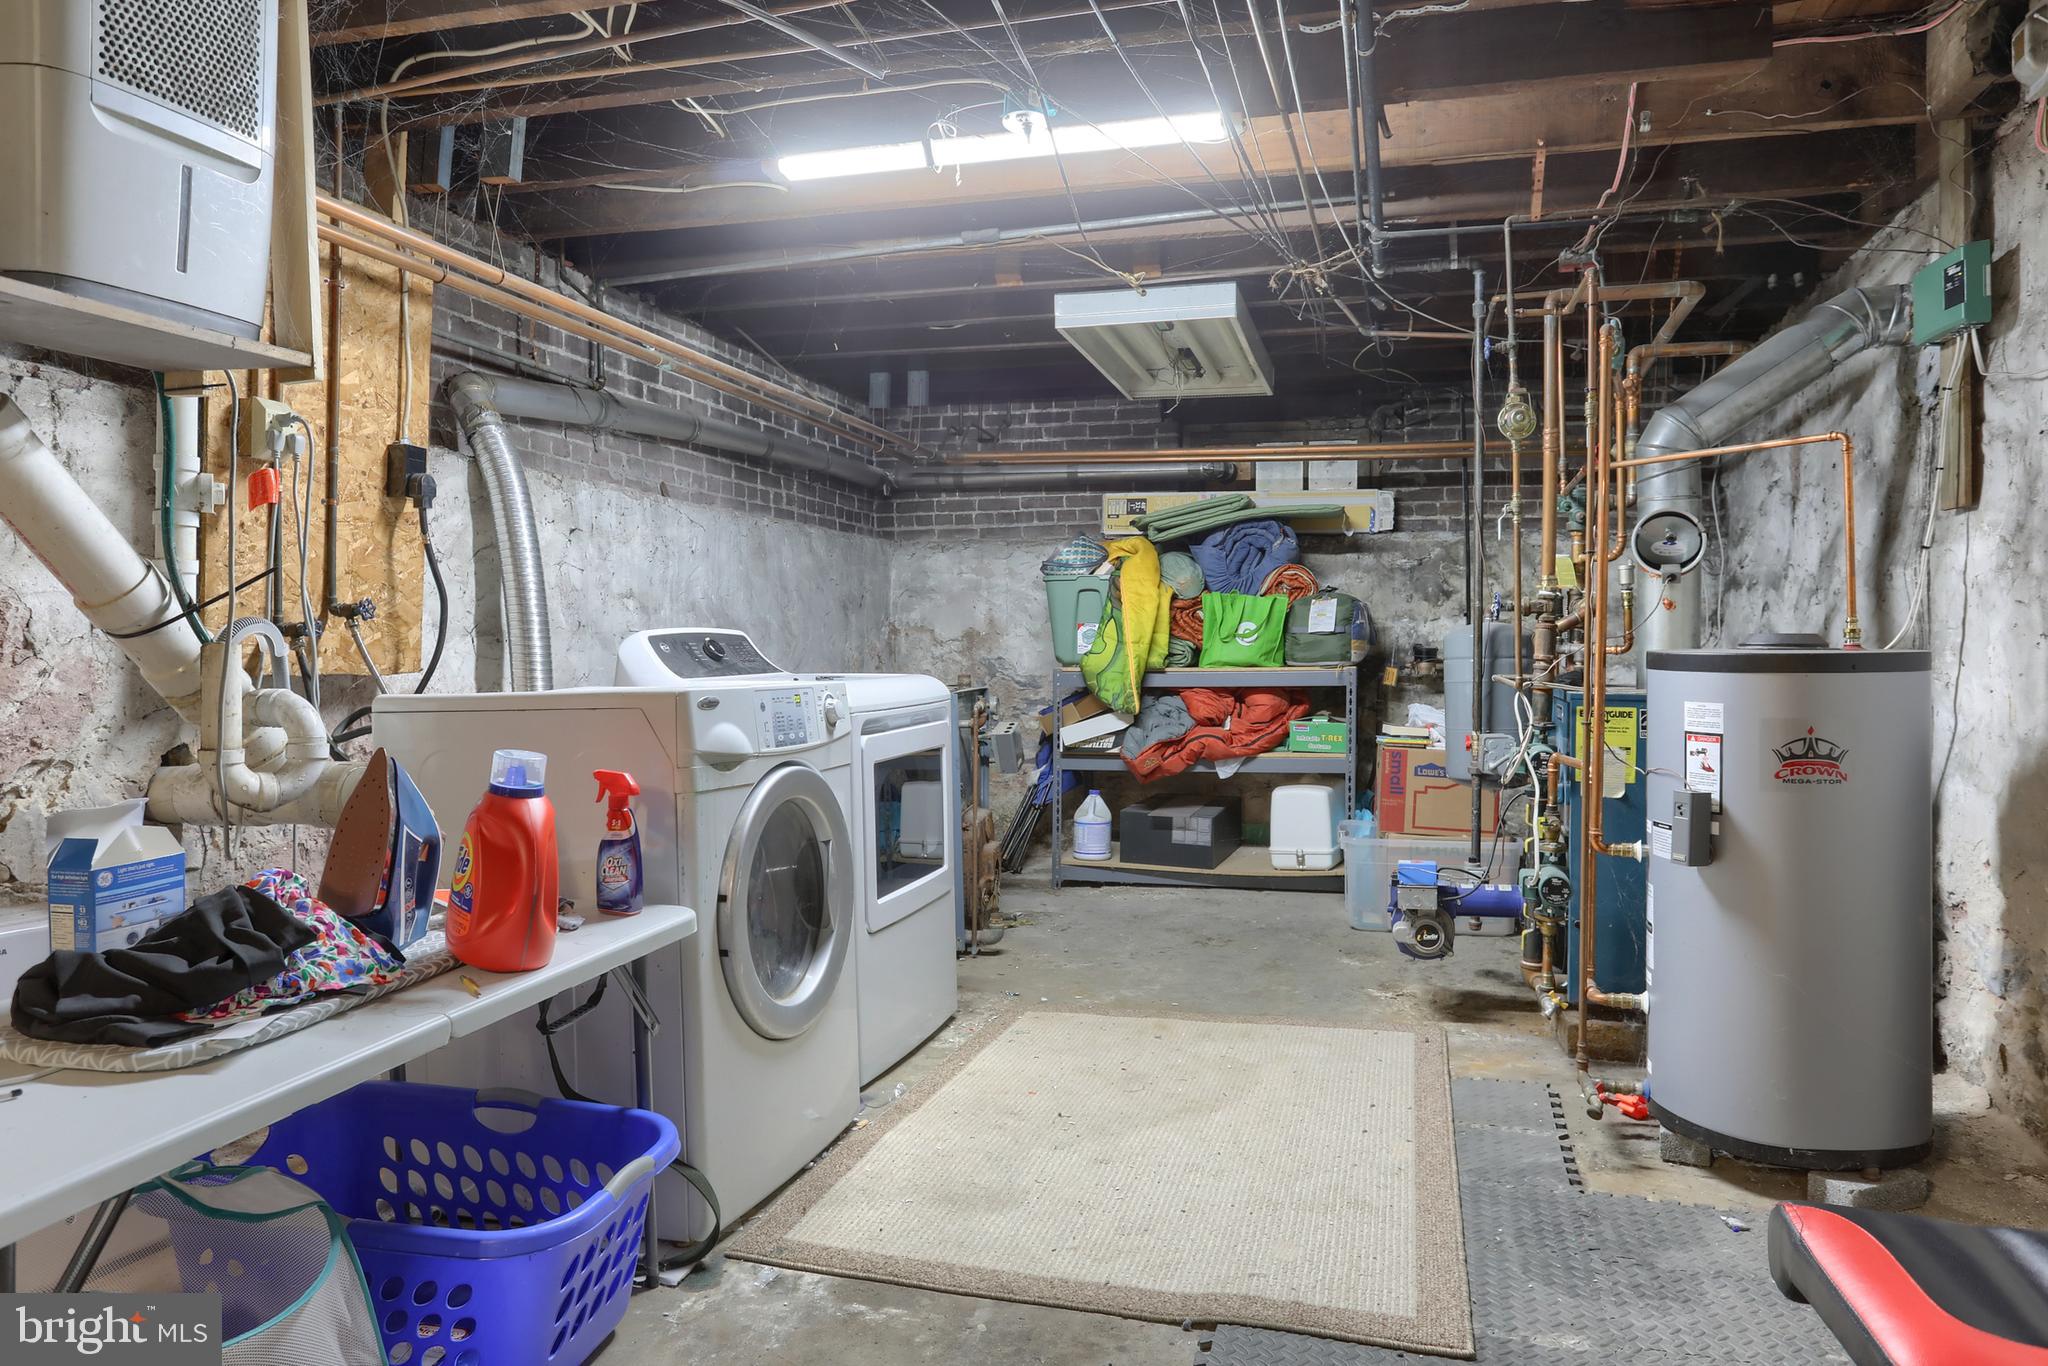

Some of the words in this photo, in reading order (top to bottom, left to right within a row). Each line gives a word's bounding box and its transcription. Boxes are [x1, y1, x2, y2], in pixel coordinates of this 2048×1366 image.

[1579, 710, 1634, 719] EEYGUIDE
[1390, 751, 1404, 795] small
[1417, 767, 1445, 777] LOWE'S
[1774, 766, 1848, 781] CROWN
